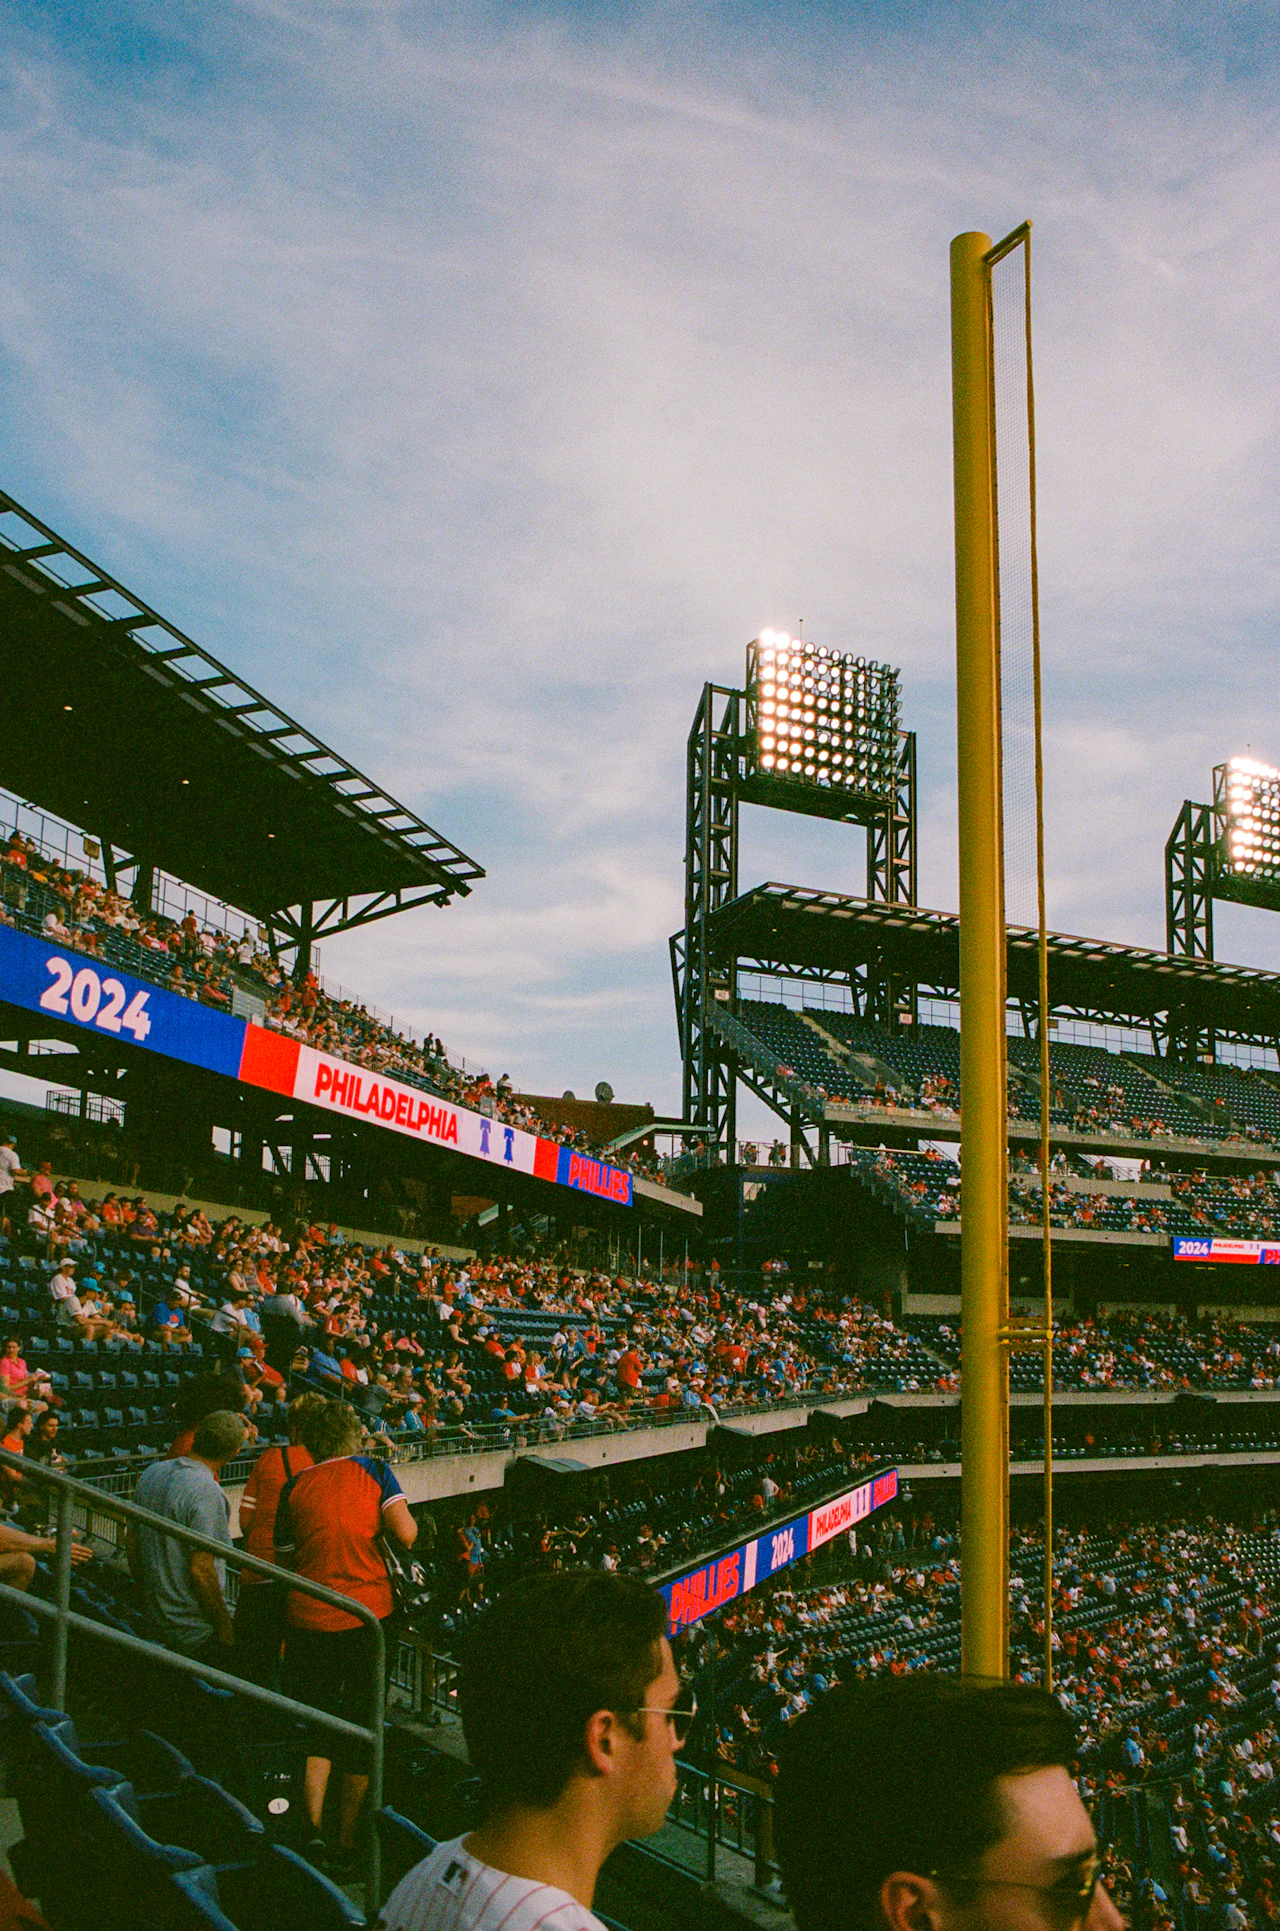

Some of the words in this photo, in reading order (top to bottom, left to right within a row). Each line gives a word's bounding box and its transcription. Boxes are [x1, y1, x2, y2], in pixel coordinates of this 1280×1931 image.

[40, 956, 151, 1041] 2024
[314, 1062, 459, 1145] PHILADELPHIA
[568, 1153, 631, 1205] PHILLIES
[1178, 1240, 1209, 1256] 2024
[670, 1552, 740, 1635] PHILLIES
[771, 1527, 795, 1571] 2024
[815, 1499, 851, 1540] PHILADELPHIA
[873, 1470, 897, 1509] PHILLIES
